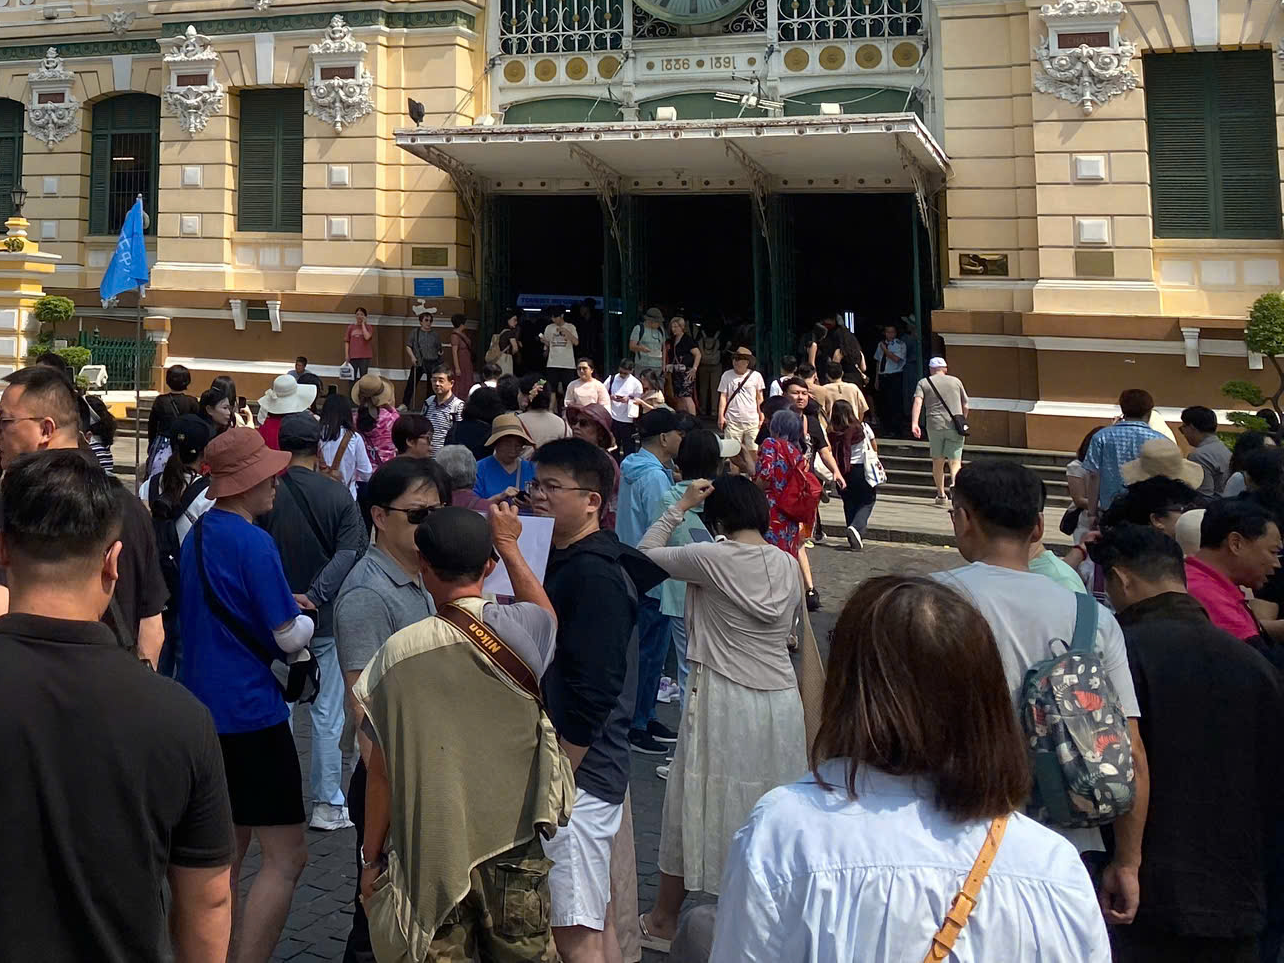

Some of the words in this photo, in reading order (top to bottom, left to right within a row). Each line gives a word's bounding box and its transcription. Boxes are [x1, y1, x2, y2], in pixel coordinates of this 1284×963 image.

[661, 58, 691, 72] 1886
[710, 56, 736, 70] 1891
[469, 623, 501, 654] Nikon
